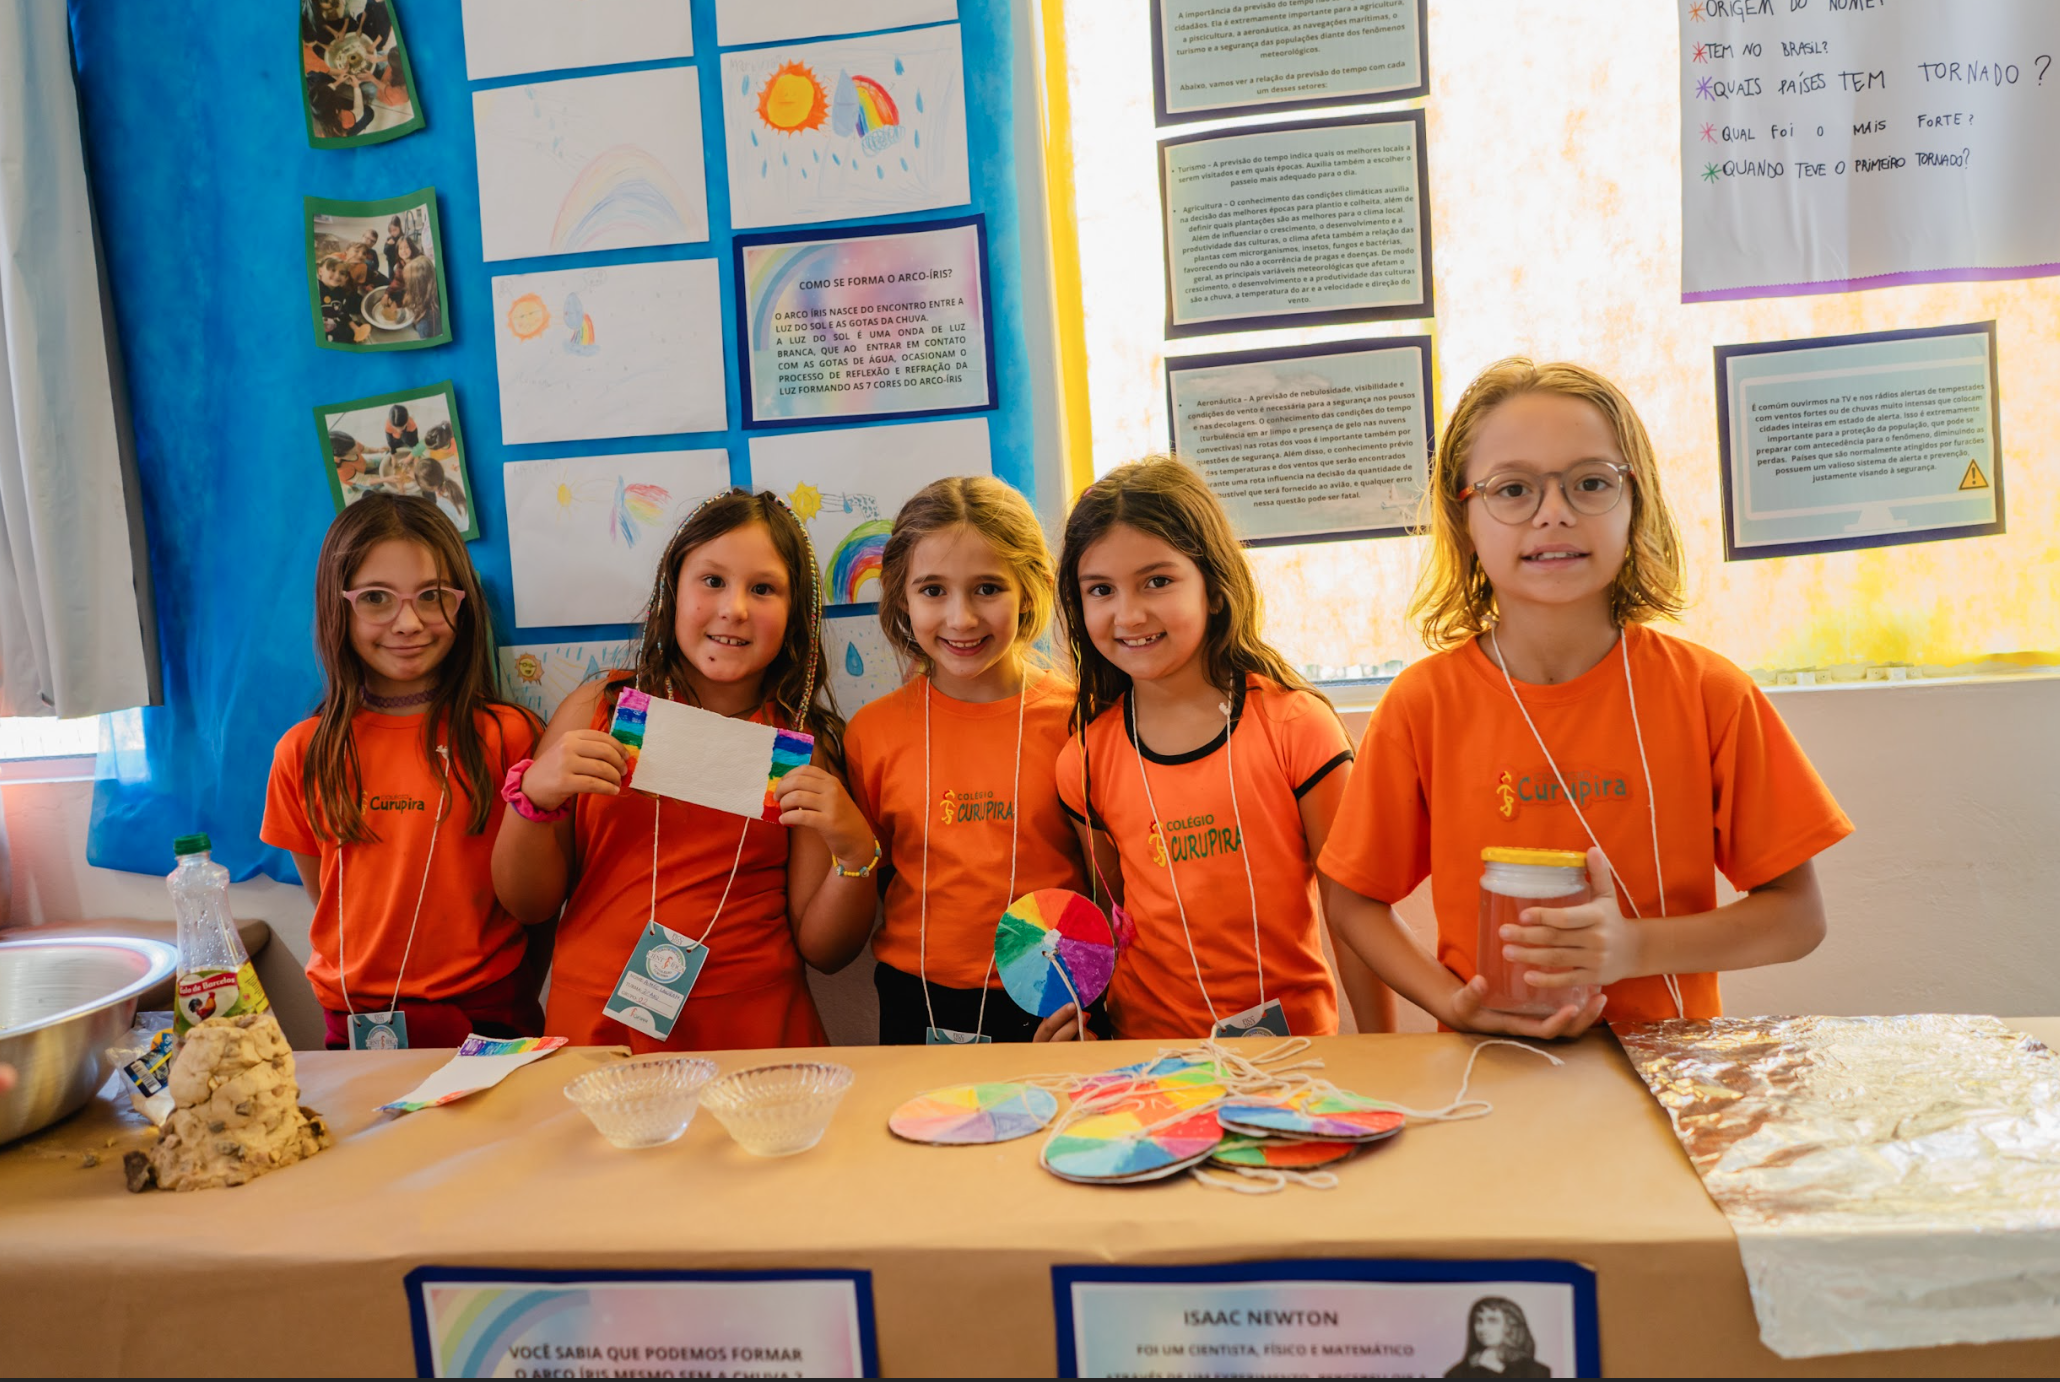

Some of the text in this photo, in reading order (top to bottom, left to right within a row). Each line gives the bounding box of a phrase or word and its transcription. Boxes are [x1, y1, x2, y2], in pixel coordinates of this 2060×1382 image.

[1260, 47, 1320, 58] meteorológicos.
[1705, 43, 1734, 59] TEM
[1743, 44, 1762, 57] NO
[1256, 74, 1284, 83] relação
[1296, 70, 1329, 80] previsão
[1387, 61, 1406, 69] cada
[1713, 78, 1762, 99] QUAIS
[1778, 71, 1826, 95] PAÍSES
[1838, 70, 1886, 92] TEM
[1918, 60, 2019, 86] TORNADO
[1722, 126, 1755, 142] QUAL
[1723, 159, 1784, 179] QUANDO
[1795, 162, 1826, 178] TEVE
[1835, 161, 1845, 175] O
[1230, 178, 1258, 188] passeio
[1279, 172, 1316, 181] adequado
[799, 268, 952, 290] COMO SE FORMA O ARCO-ÍRIS?
[784, 310, 808, 319] ARCO
[811, 308, 827, 318] ÍRIS
[829, 306, 858, 316] NASCE
[861, 305, 874, 314] DO
[877, 301, 926, 313] ENCONTRO
[929, 298, 955, 308] ENTRE
[776, 324, 792, 333] LUZ
[794, 323, 808, 332] DO
[809, 321, 827, 330] SOL
[836, 320, 847, 328] AS
[849, 318, 879, 327] GOTAS
[881, 317, 894, 325] DA
[895, 314, 928, 324] CHUVA.
[789, 336, 806, 344] LUZ
[813, 334, 826, 343] DO
[833, 333, 850, 341] SOL
[857, 328, 862, 339] É
[869, 330, 891, 338] UMA
[898, 327, 924, 337] ONDA
[931, 325, 943, 334] DE
[949, 323, 966, 332] LUZ
[777, 336, 966, 358] BRANCA, QUE AO ENTRAR EM CONTATO
[778, 348, 967, 370] COM AS GOTAS DE ÁGUA, OCASIONAM O
[779, 361, 968, 382] PROCESSO DE REFLEXÃO E REFRAÇÃO DA
[779, 387, 796, 396] LUZ
[798, 383, 851, 394] FORMANDO
[853, 382, 864, 390] AS
[873, 379, 902, 389] CORES
[904, 378, 917, 387] DO
[919, 374, 962, 385] ARCO-ÍRIS
[1775, 466, 1812, 476] possuem
[1856, 458, 1886, 467] sistema
[1813, 472, 1857, 484] justamente
[1859, 468, 1888, 477] visando
[1896, 464, 1936, 474] segurança.
[1276, 497, 1306, 506] questão
[1308, 495, 1327, 504] pode
[1518, 776, 1626, 805] Curupira
[370, 796, 424, 814] Curupira
[957, 801, 1013, 822] CURUPIRA
[1166, 814, 1214, 831] COLÉGIO
[202, 977, 235, 989] Barcelos
[1184, 1310, 1338, 1326] ISAAC NEWTON
[509, 1343, 802, 1362] VOCÊ SABIA QUE PODEMOS FORMAR
[1137, 1344, 1414, 1356] FOI UM CIENTISTA, FÍSICO E MATEMÁTICO
